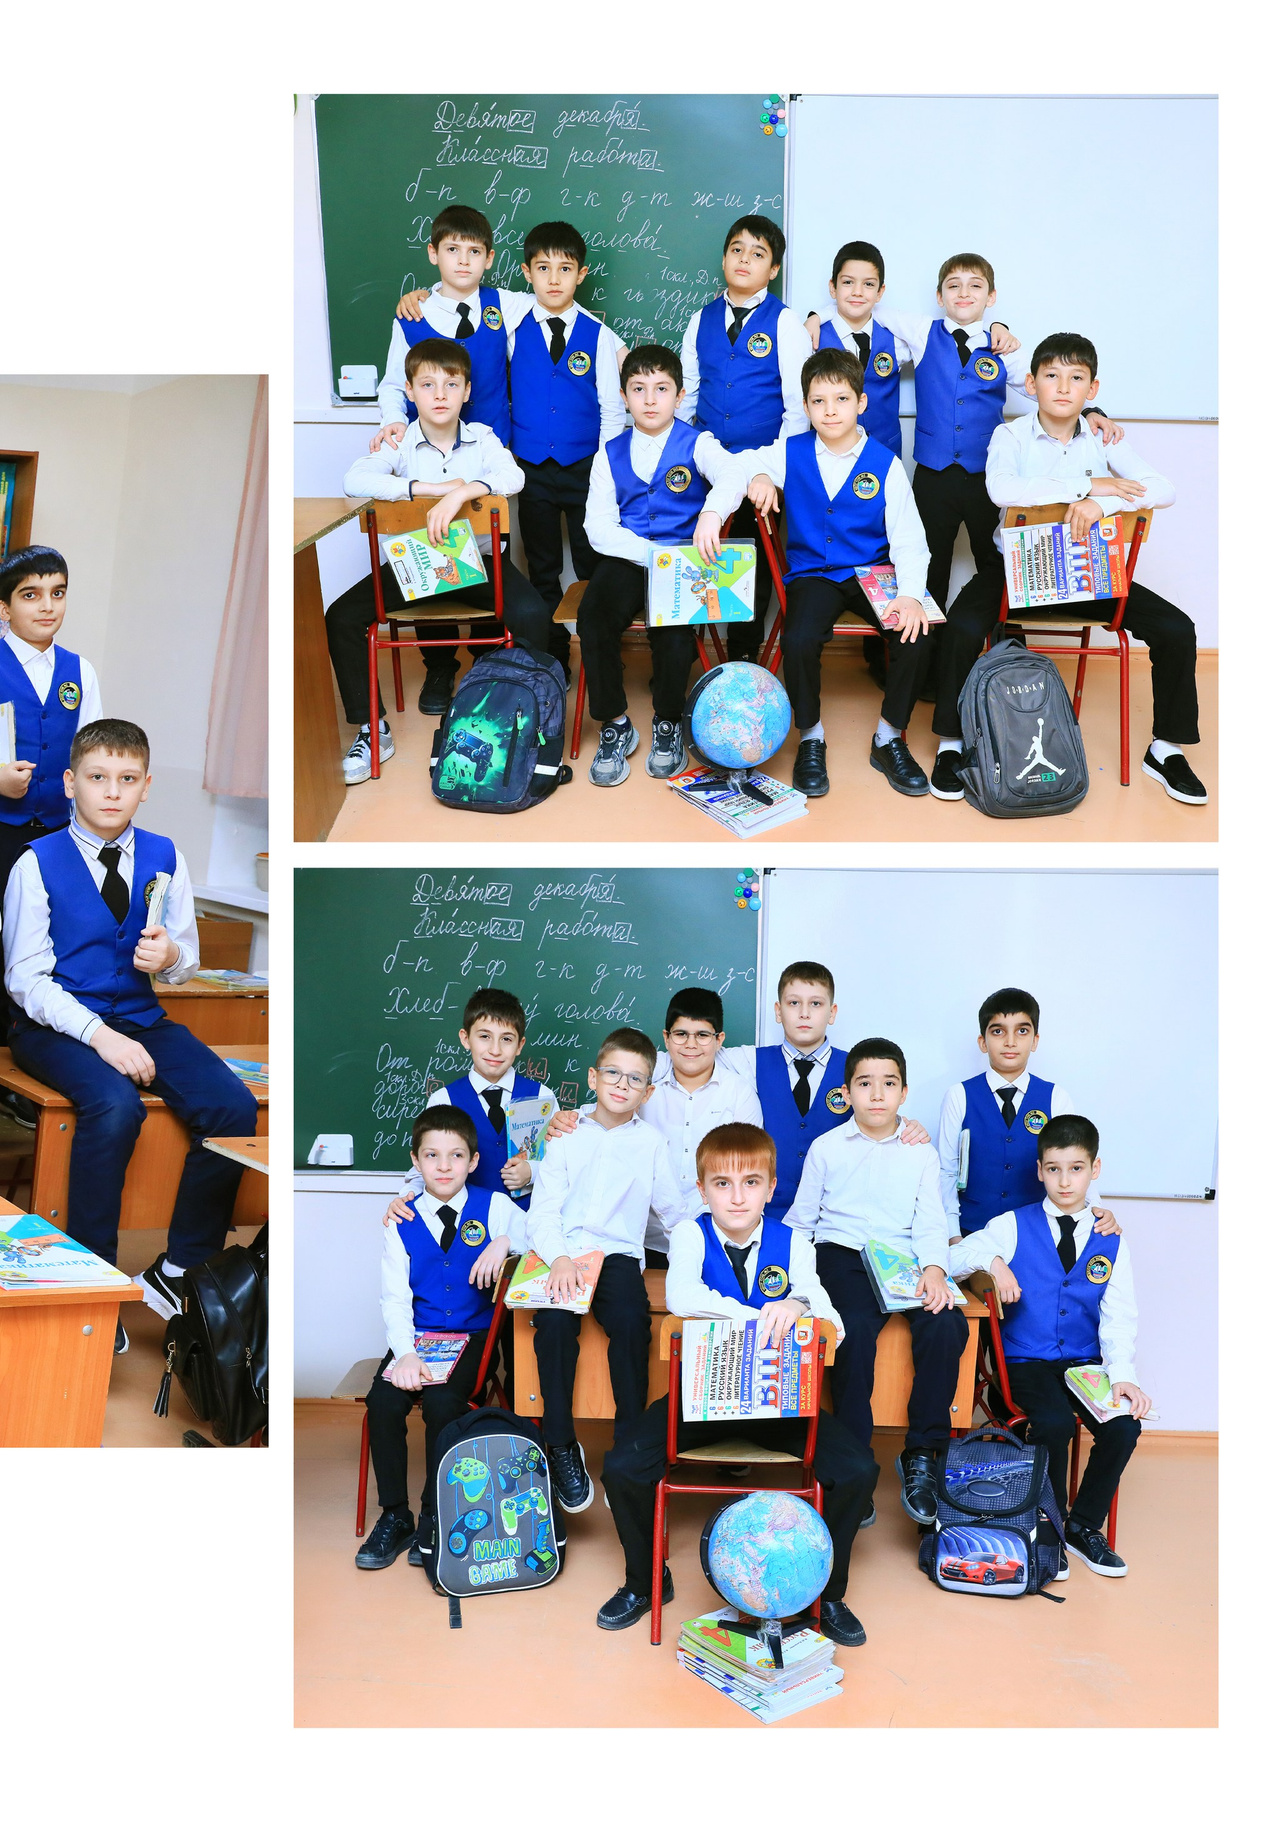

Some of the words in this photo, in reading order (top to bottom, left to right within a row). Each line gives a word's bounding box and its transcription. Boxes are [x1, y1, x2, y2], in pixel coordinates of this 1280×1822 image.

[416, 544, 433, 570] МИР
[1090, 529, 1098, 560] ЗАДАНИЯ
[407, 538, 430, 592] Окружающий
[1026, 548, 1035, 591] МАТЕМАТИКА
[1042, 551, 1050, 590] ОКРУЖАЮЩИЙ
[1057, 559, 1066, 588] ВАРИАНТА
[1092, 562, 1100, 594] ТИПОВЫЕ
[1100, 545, 1108, 580] ПРЕДМЕТЫ
[672, 558, 682, 619] Математика
[1058, 588, 1068, 600] 24
[1042, 773, 1056, 781] 23
[376, 1043, 413, 1072] От
[511, 1118, 544, 1132] Математика
[372, 1131, 397, 1160] до
[745, 1328, 754, 1362] ЗАДАНИЙ
[784, 1330, 793, 1368] ЗАДАНИЯ
[710, 1346, 720, 1400] МАТЕМАТИКА
[718, 1363, 726, 1400] РУССКИЙ
[726, 1347, 734, 1400] ОКРУЖАЮЩИЙ
[733, 1353, 742, 1400] ЛИТЕРАТУРНОЕ
[744, 1363, 752, 1400] ВАРИАНТА
[791, 1350, 799, 1394] ПРЕДМЕТЫ
[741, 1400, 752, 1414] 24
[782, 1370, 790, 1411] ТИПОВЫЕ
[790, 1394, 798, 1410] ВСЕ
[800, 1399, 806, 1410] ЗА
[473, 1538, 521, 1560] MAIN
[468, 1560, 519, 1586] GAME
